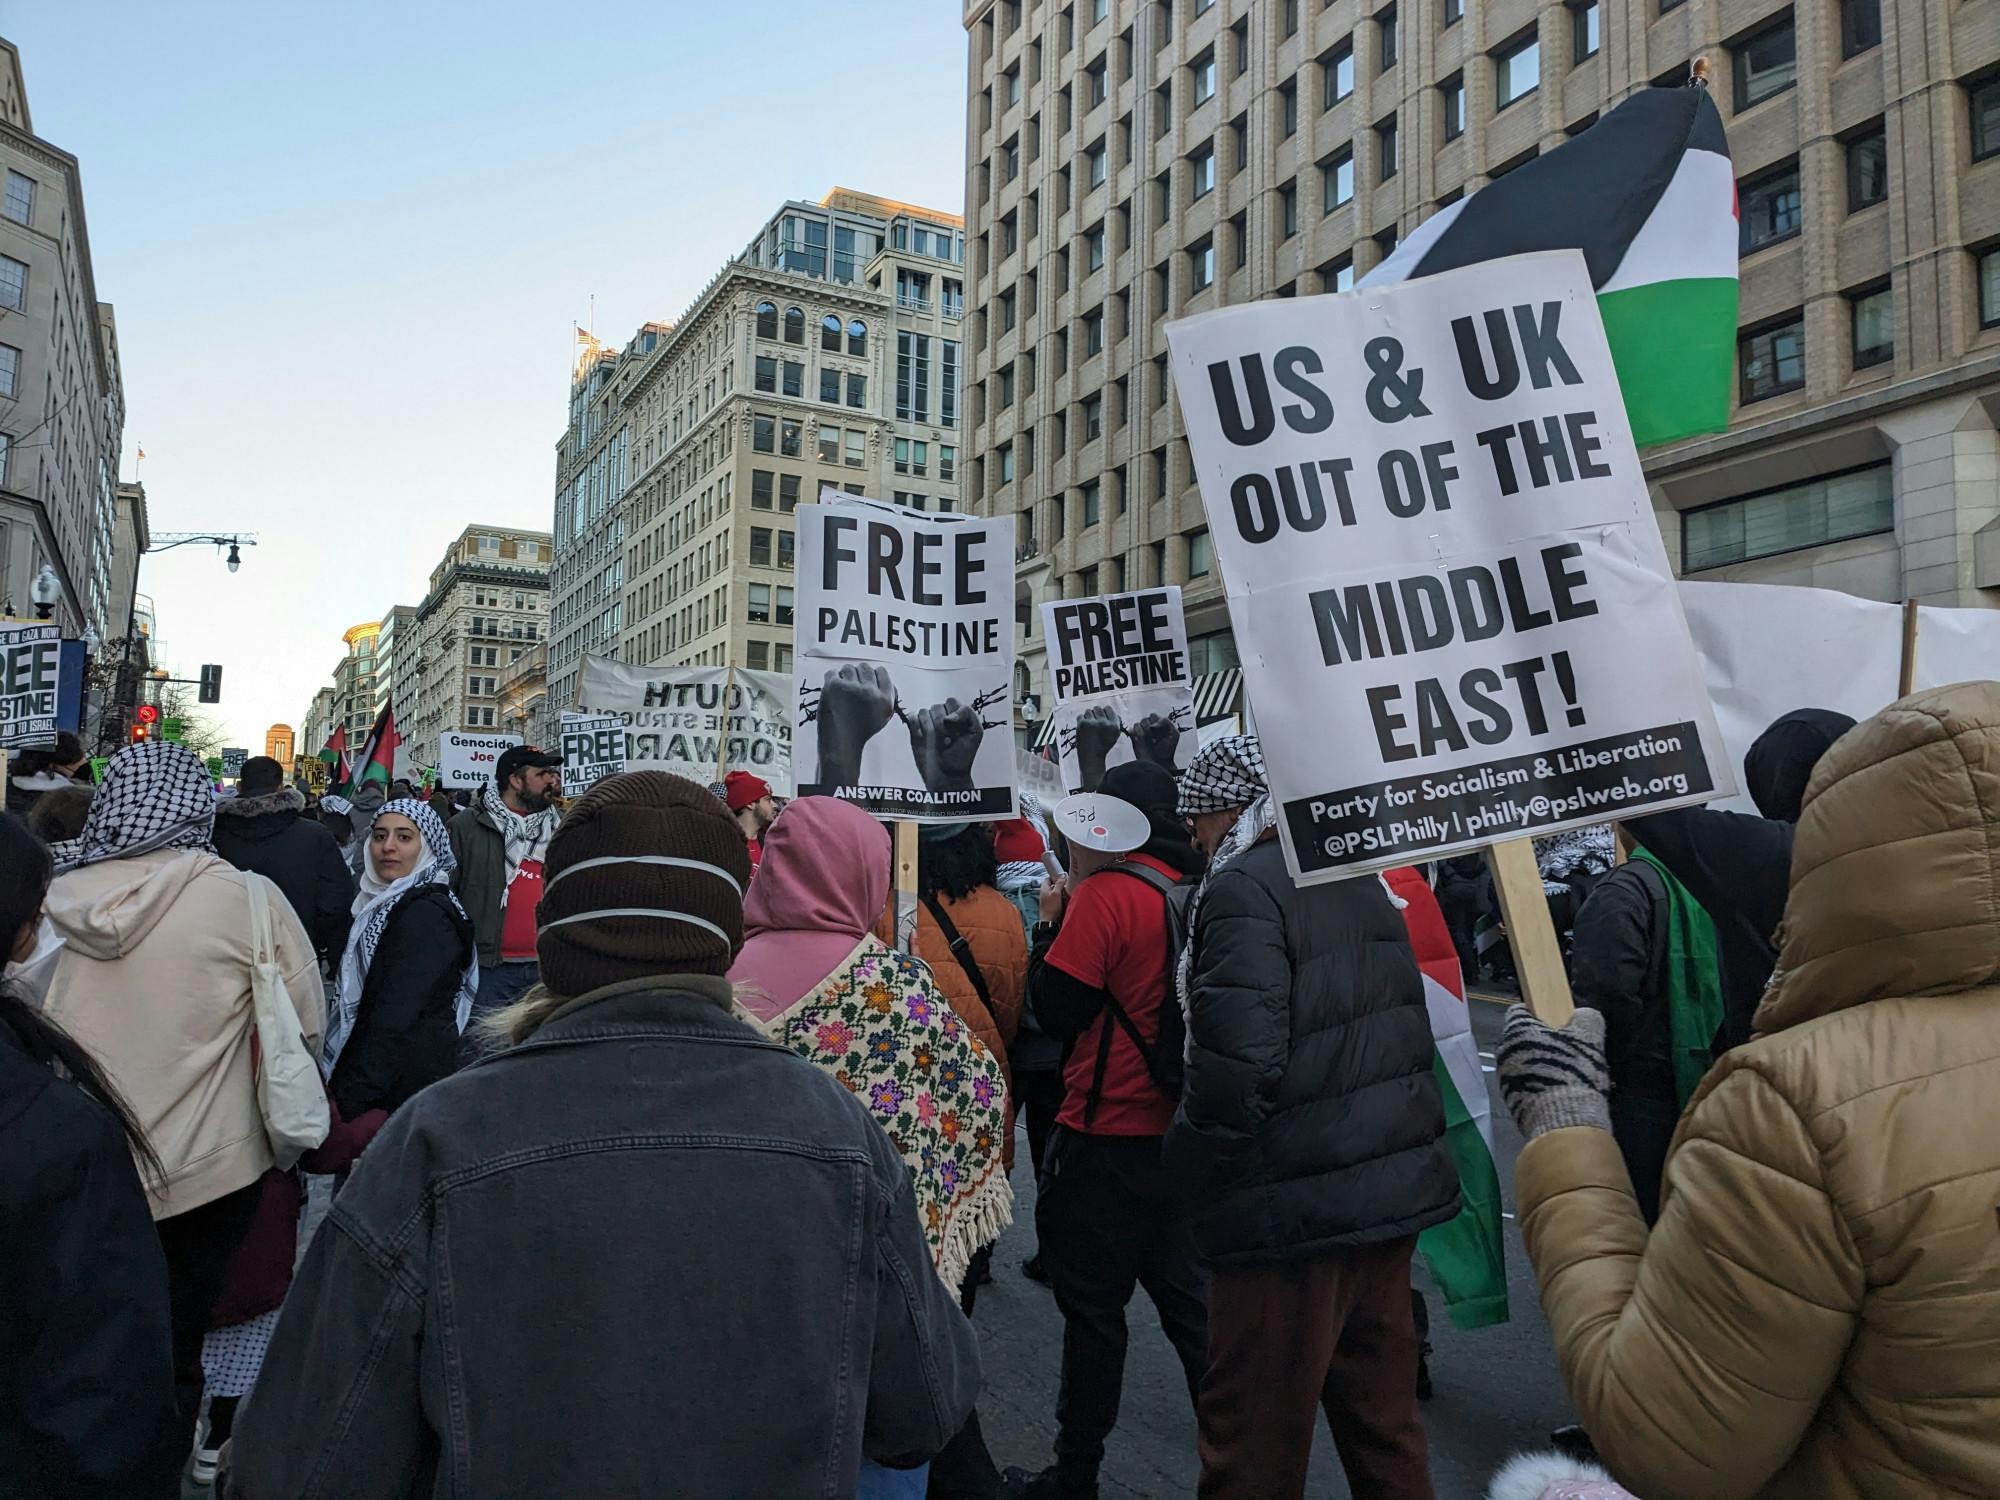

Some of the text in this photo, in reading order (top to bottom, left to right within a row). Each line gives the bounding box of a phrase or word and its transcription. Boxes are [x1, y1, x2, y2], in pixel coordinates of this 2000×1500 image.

[1207, 301, 1584, 447] US & UK
[1230, 411, 1612, 544] OUT OF THE
[822, 515, 987, 606] FREE
[1053, 593, 1174, 666] FREE
[1308, 542, 1599, 667] MIDDLE
[22, 628, 39, 642] GAZA
[818, 607, 999, 657] PALESTINE
[0, 642, 58, 695] EE
[1055, 651, 1187, 699] PALESTINE
[2, 719, 54, 737] AID TO ISRAEL
[1365, 650, 1587, 763] EAST!
[450, 735, 514, 750] Genocide
[470, 751, 495, 763] Joe
[563, 729, 624, 767] FREE
[452, 769, 490, 782] Gotta
[833, 785, 982, 805] ANSWER COALITION
[1310, 733, 1682, 823] Party for Socialism & Liberation
[1067, 805, 1096, 824] PSL
[1323, 815, 1449, 858] @PSLPhilly
[1466, 771, 1689, 837] philly@pslweb.org
